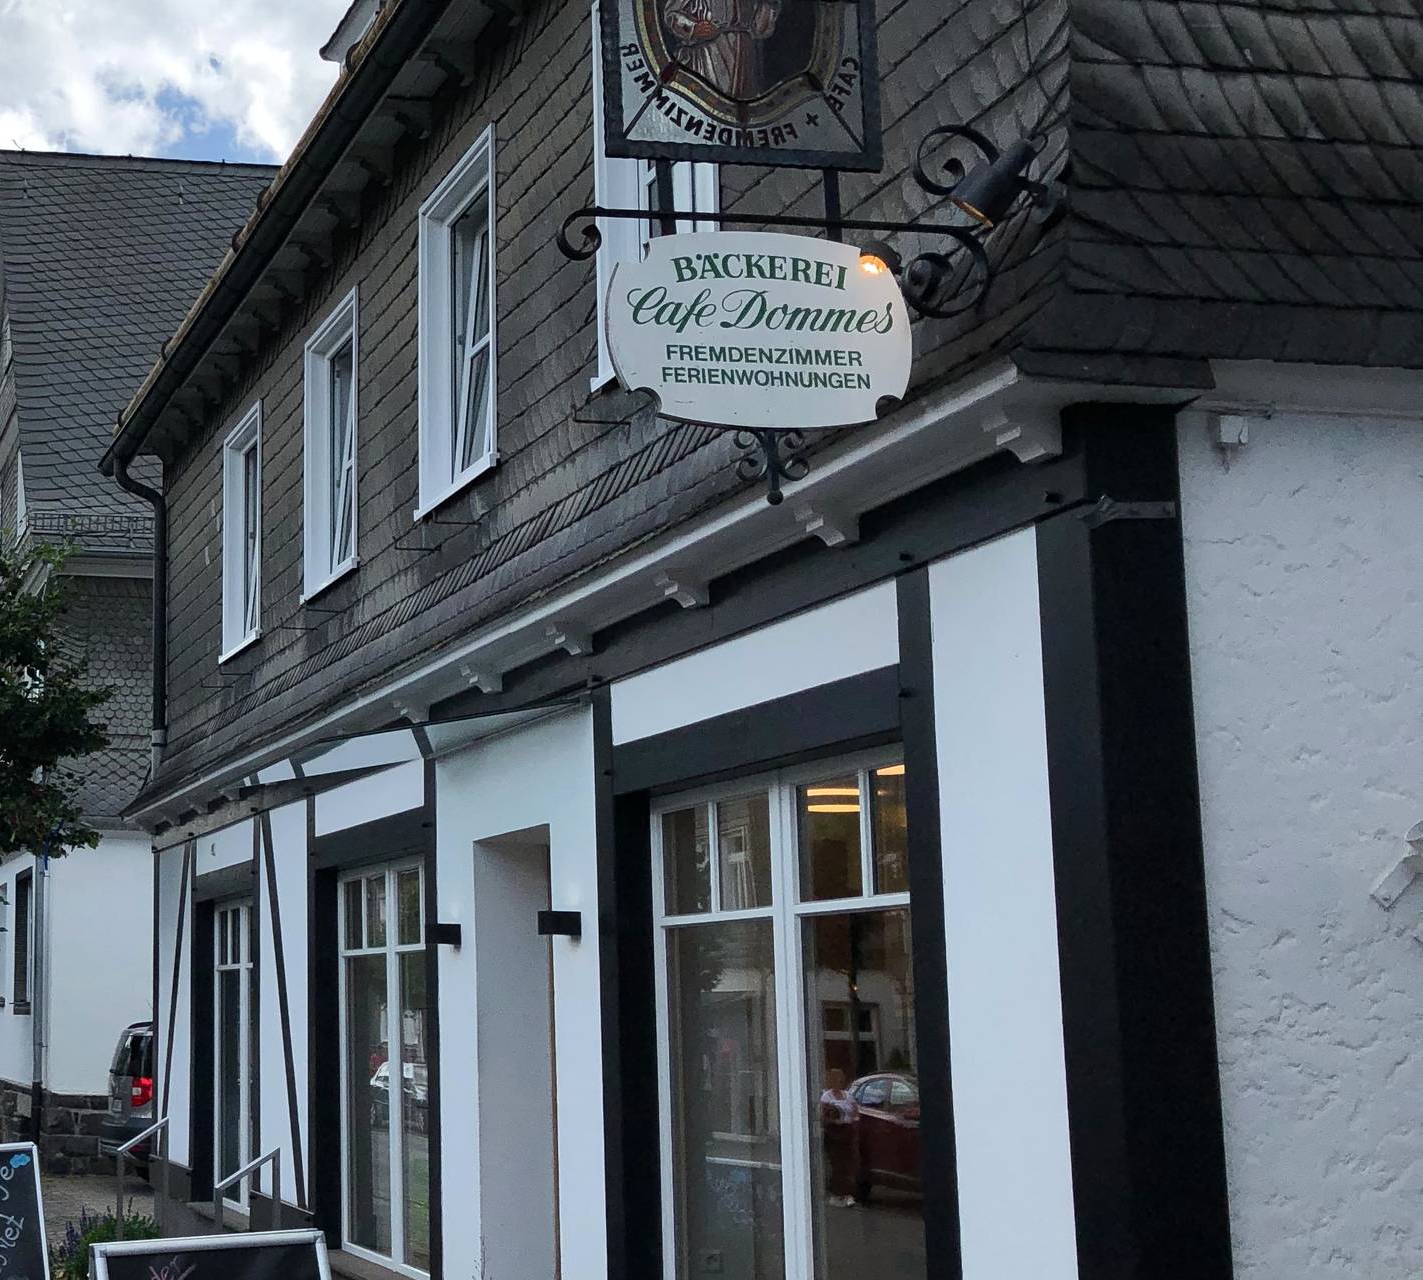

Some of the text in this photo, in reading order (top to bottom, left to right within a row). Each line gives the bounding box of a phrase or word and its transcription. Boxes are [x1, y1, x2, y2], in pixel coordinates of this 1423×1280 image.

[671, 253, 848, 291] BÄCKEREI
[626, 286, 894, 334] Cafe Dommes
[666, 344, 863, 367] FREMDENZIMMER
[661, 366, 871, 390] FERIENWOHNUNGEN
